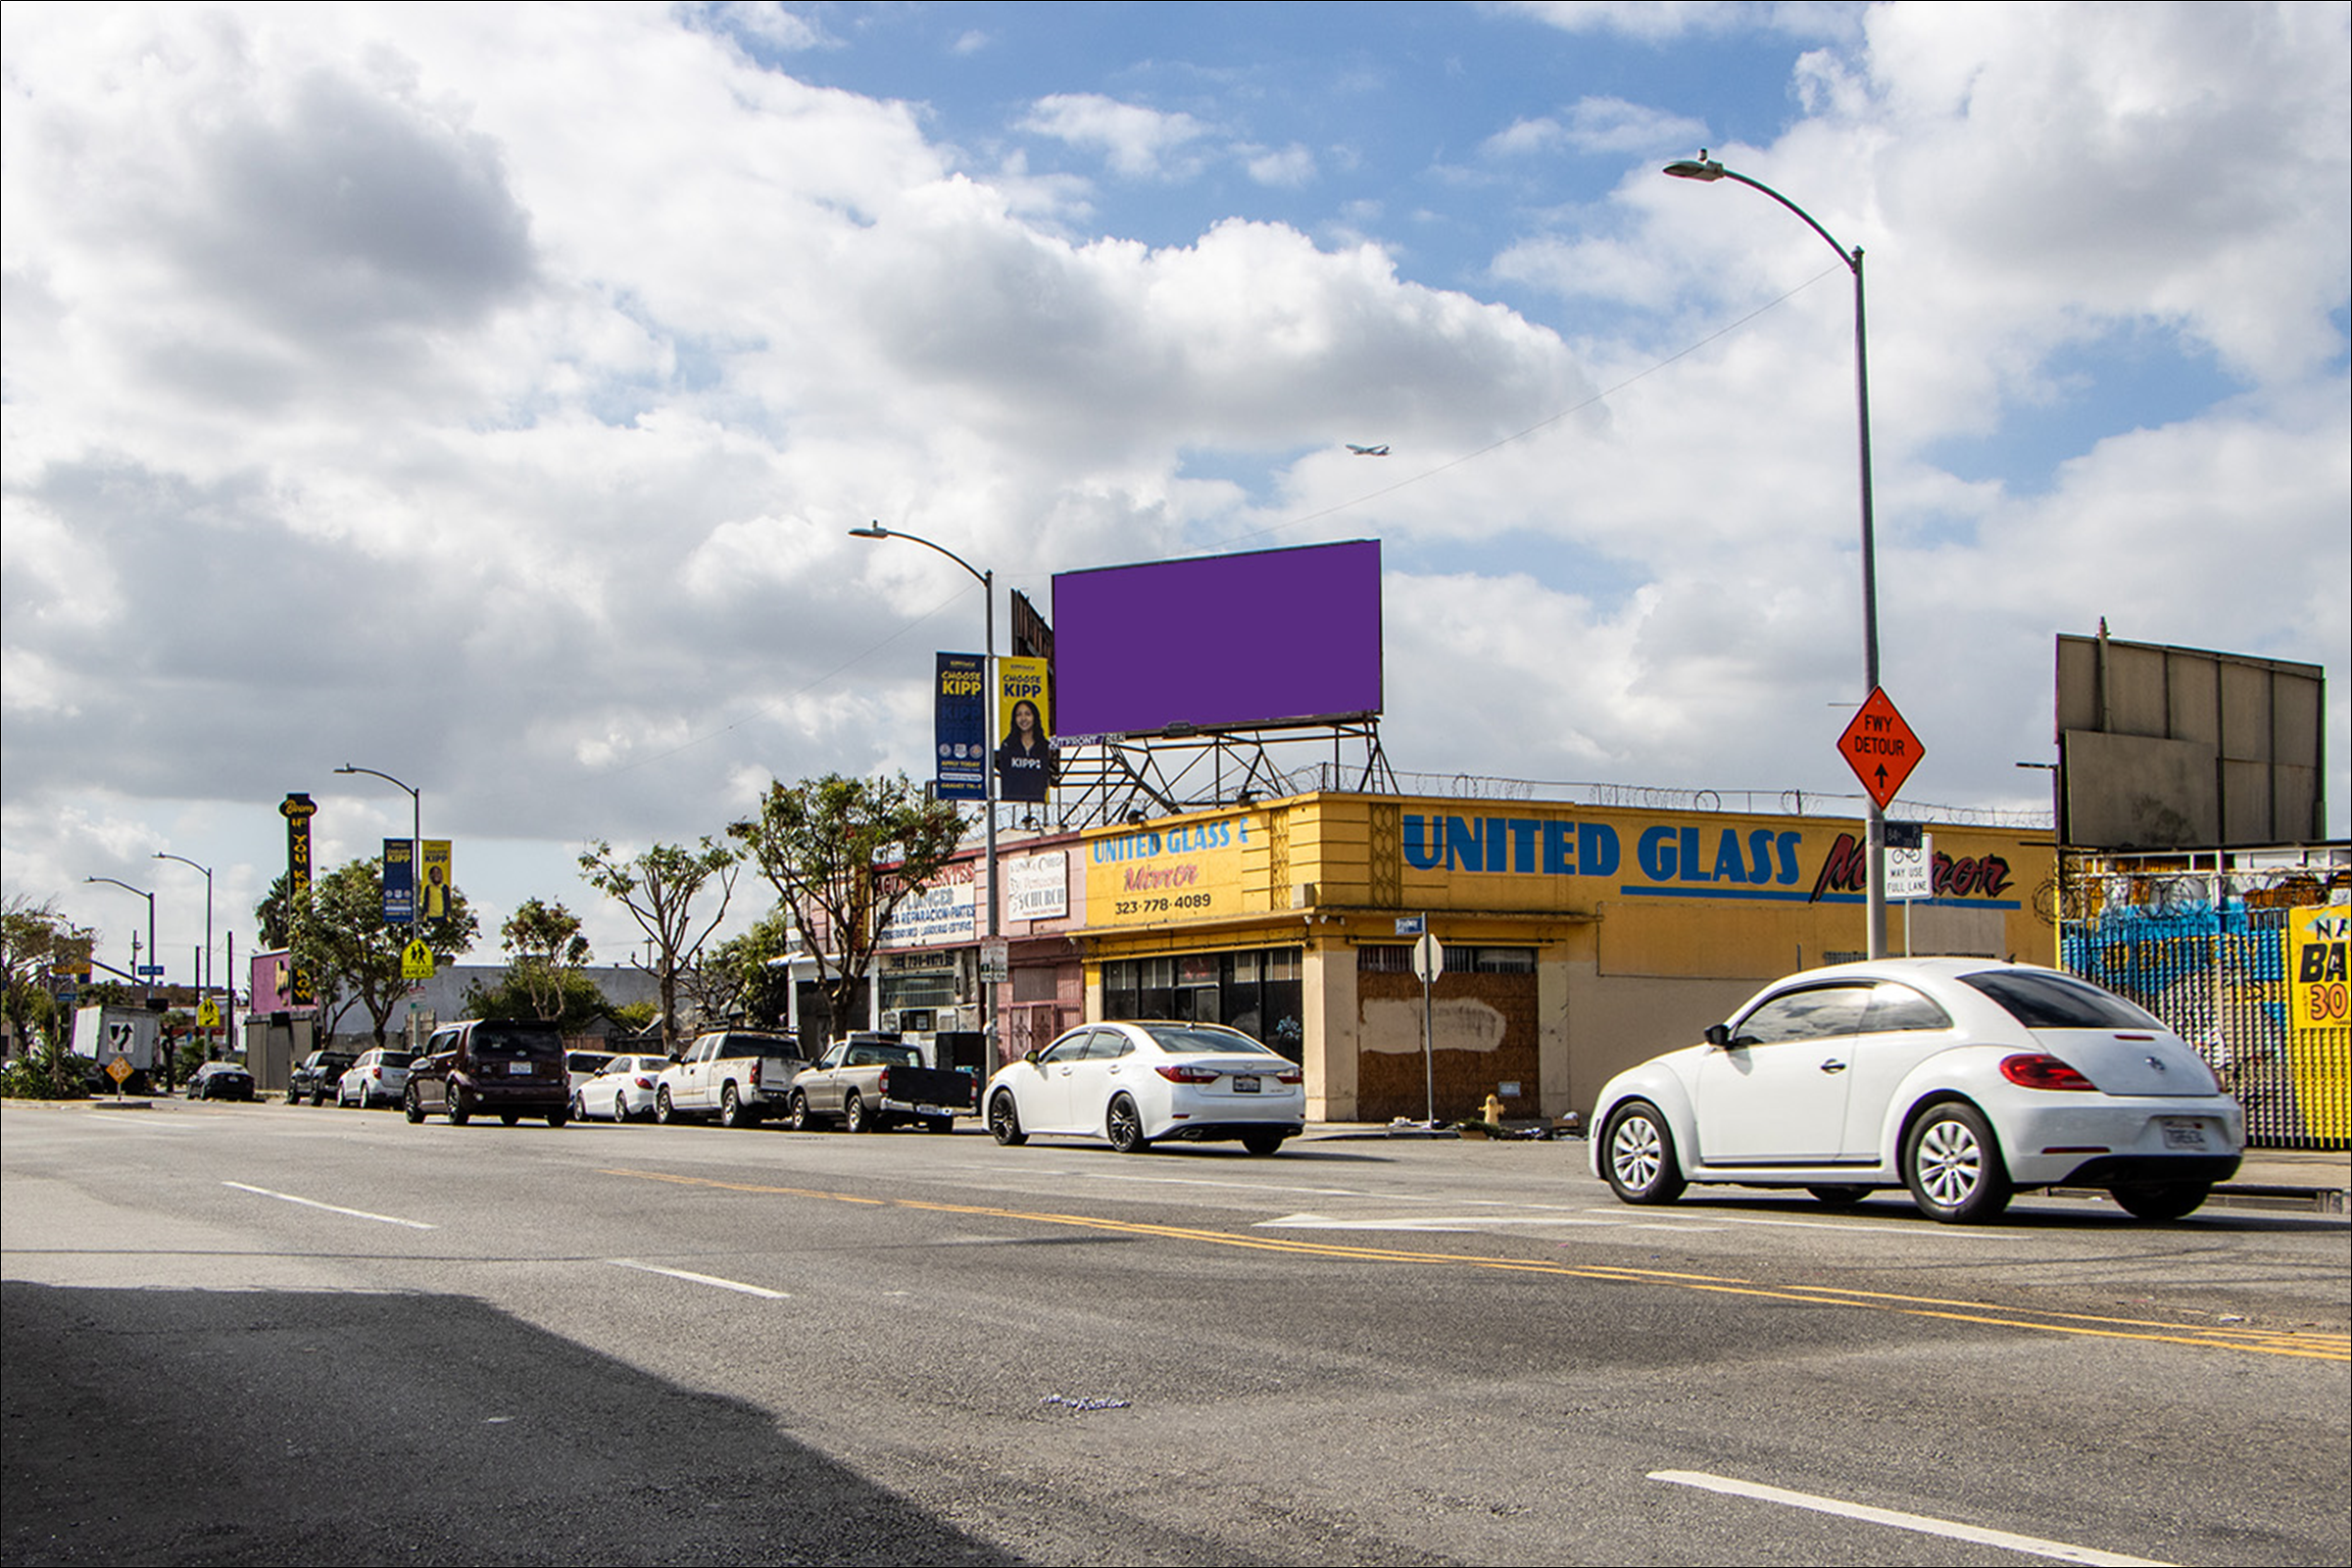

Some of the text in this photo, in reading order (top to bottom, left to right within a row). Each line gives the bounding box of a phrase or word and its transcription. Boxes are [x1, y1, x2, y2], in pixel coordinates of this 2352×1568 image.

[942, 670, 982, 681] CHOOSE
[1003, 673, 1042, 684] CHOOSE
[942, 680, 982, 695] KIPP
[1004, 683, 1042, 698] KIPP
[1864, 713, 1893, 733] FWY
[1854, 735, 1905, 757] DETOUR
[1093, 831, 1161, 863] UNITED
[1166, 820, 1231, 854] GLASS
[1402, 814, 1802, 886] UNITED GLASS
[387, 855, 412, 863] KIPP
[1809, 832, 2015, 903] Mror
[1123, 863, 1200, 893] Mirror
[1890, 866, 1924, 878] MAY USE
[1886, 880, 1928, 893] FULL LANE
[1024, 887, 1064, 908] CHURCH
